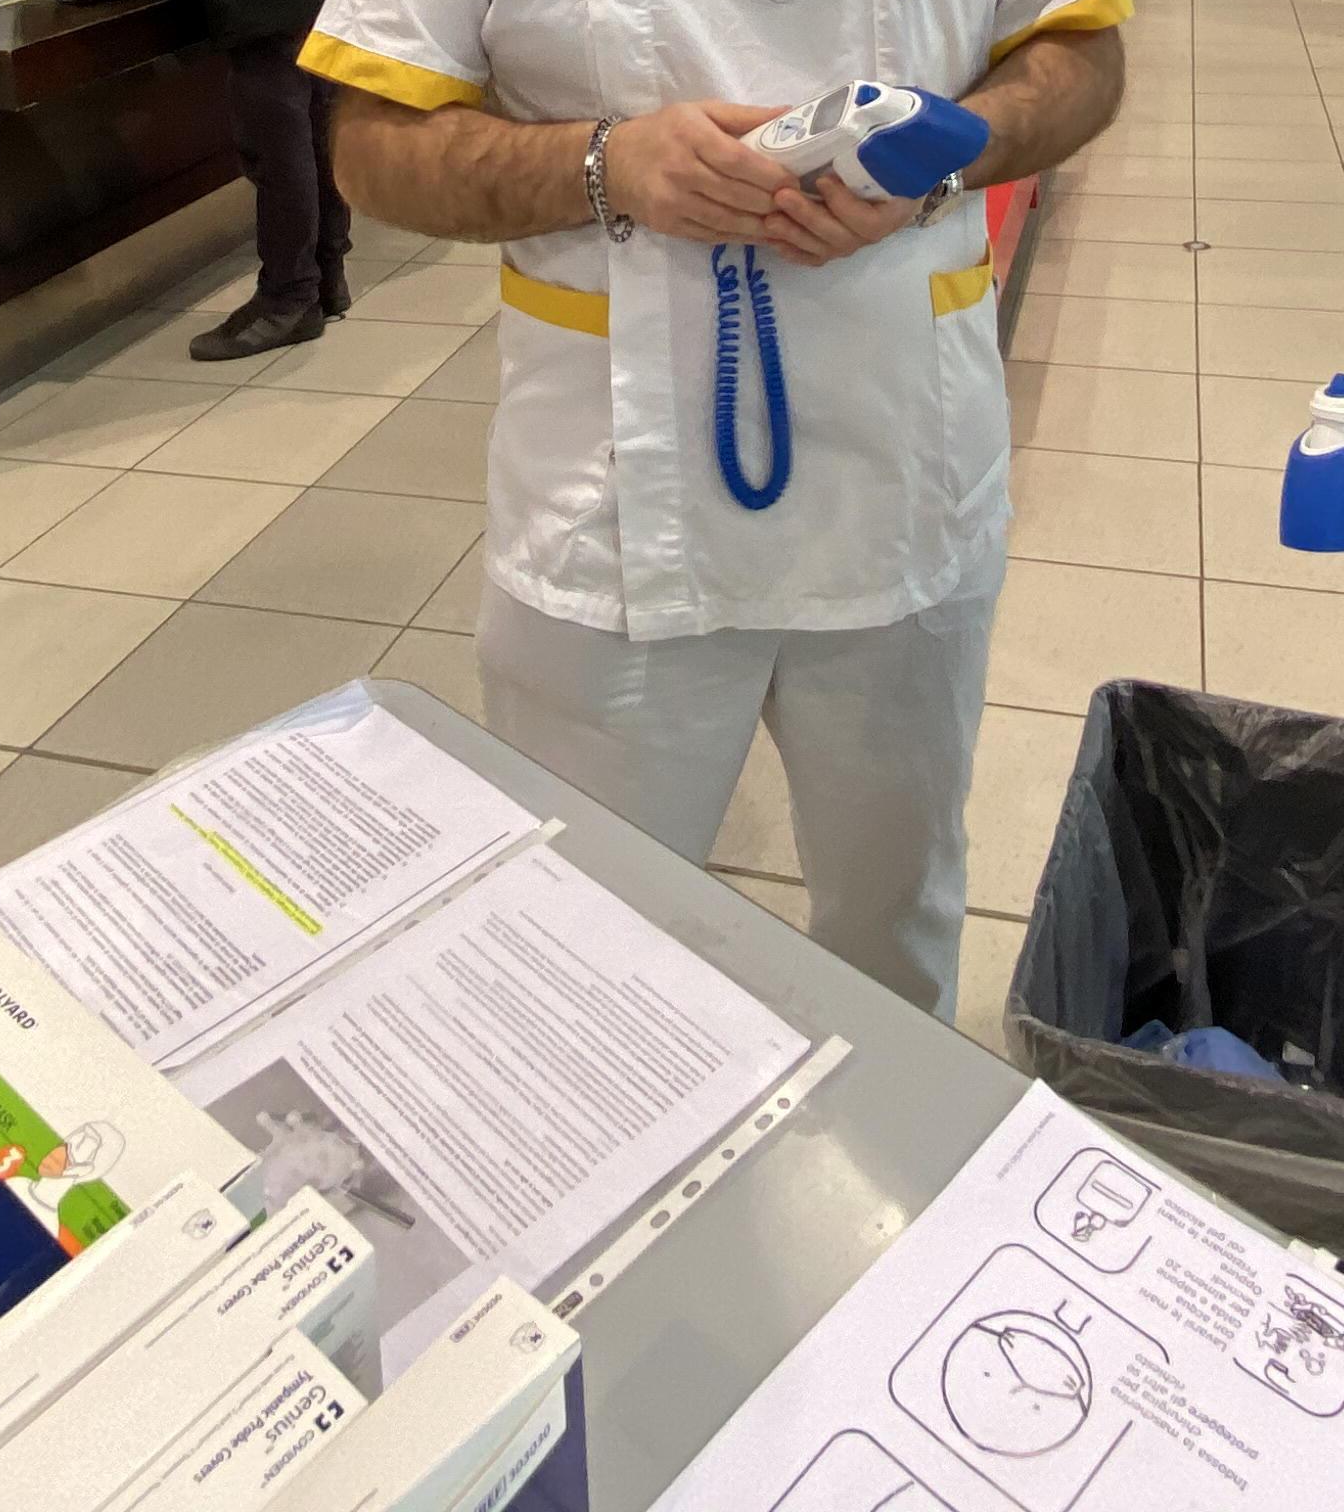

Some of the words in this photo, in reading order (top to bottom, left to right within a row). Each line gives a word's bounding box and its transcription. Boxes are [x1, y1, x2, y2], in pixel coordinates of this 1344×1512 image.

[1157, 1207, 1185, 1229] mani
[251, 1259, 282, 1285] Probe
[283, 1234, 338, 1281] Genius
[1165, 1258, 1181, 1272] 20
[1201, 1237, 1257, 1278] Frizionare
[1156, 1266, 1197, 1298] sapone
[1184, 1270, 1227, 1301] almeno
[1211, 1274, 1255, 1307] secondi
[1220, 1262, 1262, 1296] Oppure
[217, 1285, 252, 1315] Covers
[1139, 1287, 1168, 1310] mani
[1175, 1295, 1211, 1322] acqua
[1229, 1301, 1250, 1317] per
[1211, 1303, 1242, 1329] calda
[1213, 1321, 1235, 1339] con
[1118, 1376, 1140, 1392] per
[1126, 1364, 1140, 1377] se
[1135, 1353, 1185, 1390] richiesto
[1143, 1376, 1168, 1394] altri
[261, 1370, 314, 1418] Tympanic
[266, 1385, 326, 1442] Genius
[1111, 1386, 1179, 1438] mascherina
[1142, 1390, 1201, 1436] chirurgica
[230, 1415, 264, 1448] Probe
[1188, 1406, 1259, 1460] proteggere
[193, 1447, 232, 1483] Covers
[1198, 1448, 1248, 1491] Indossa
